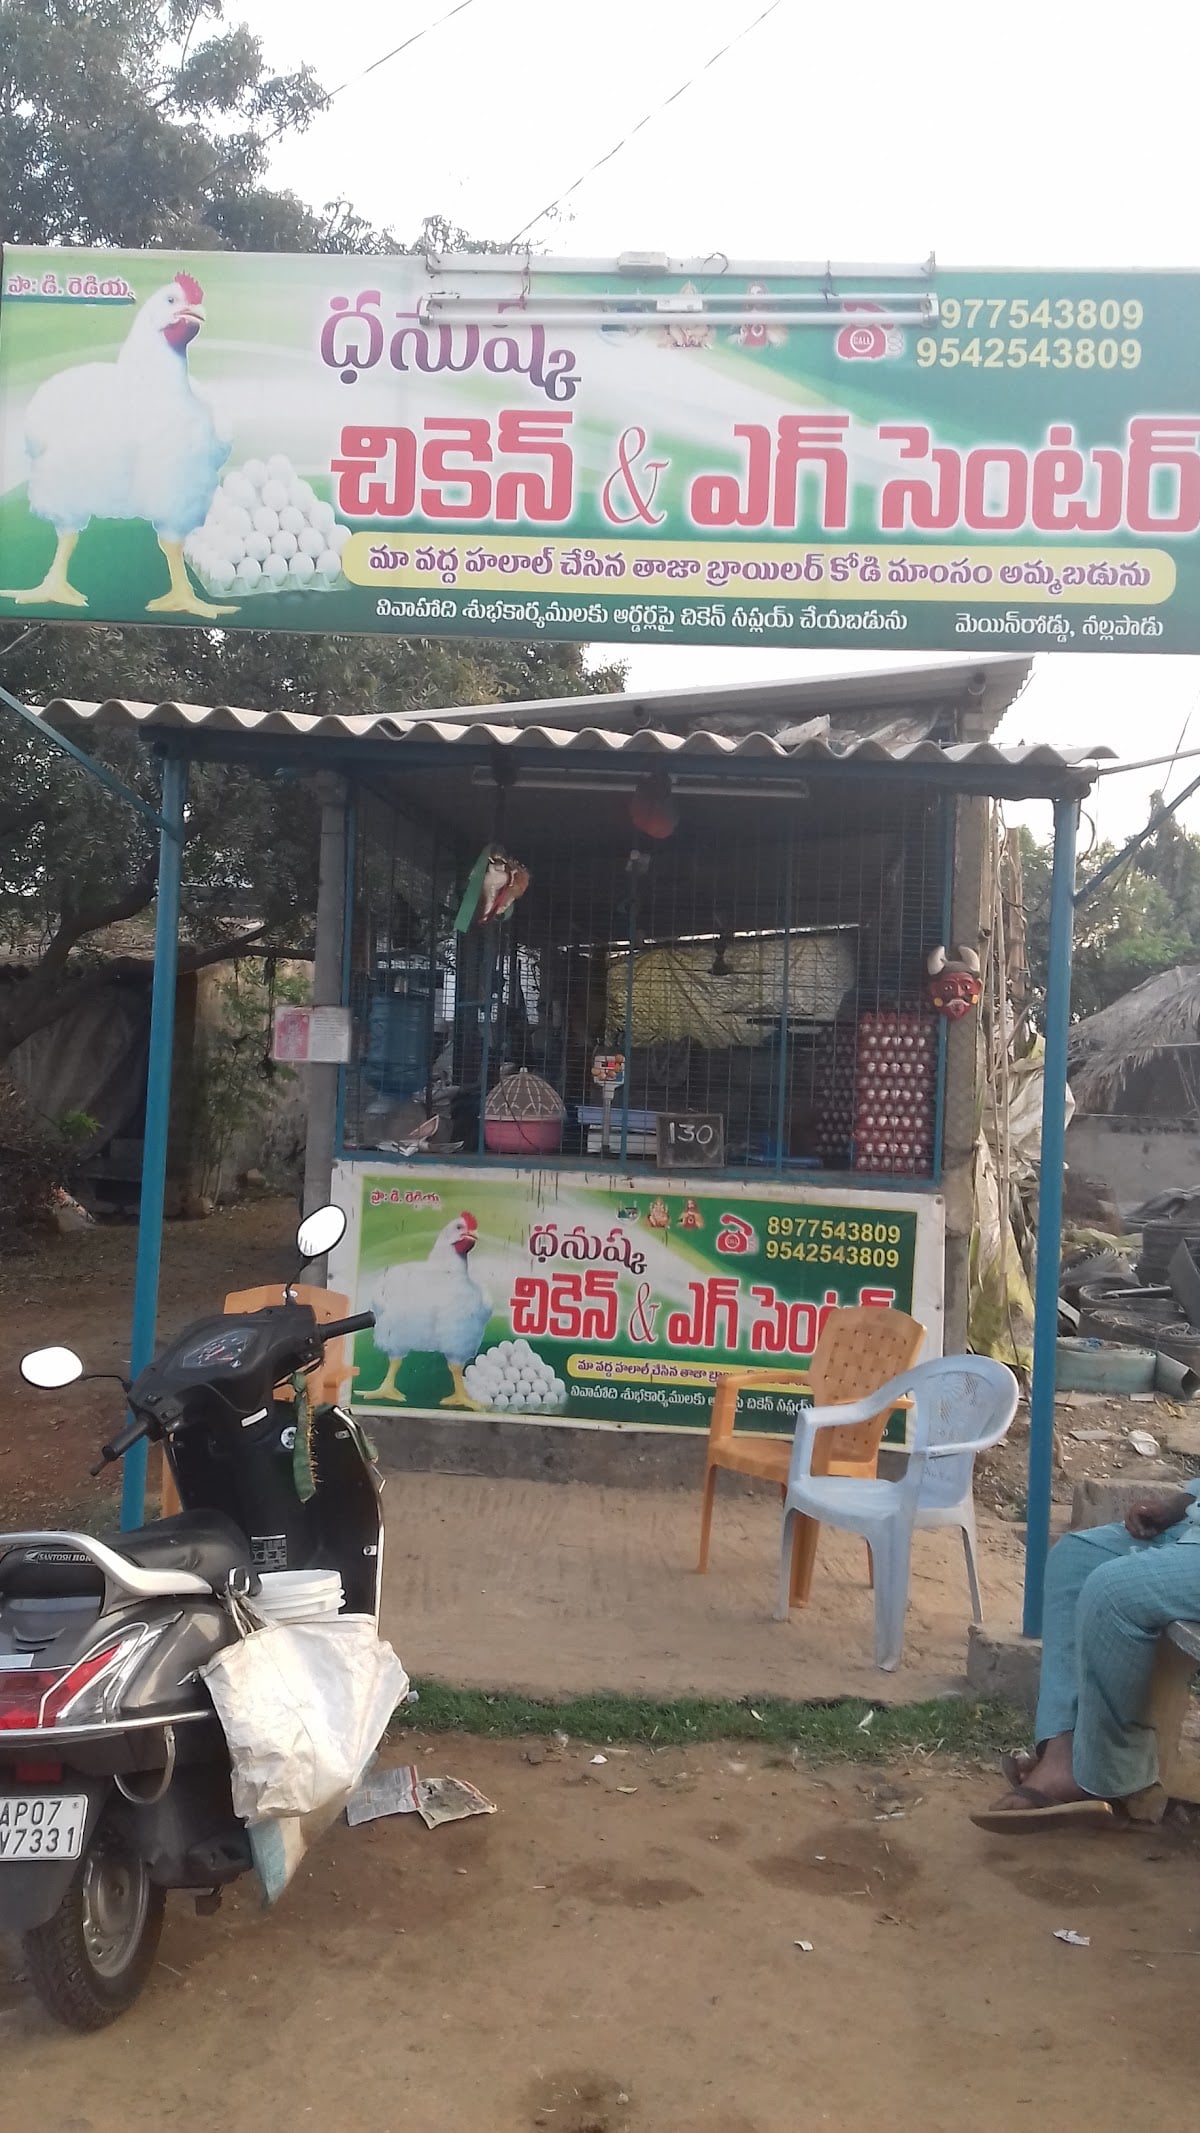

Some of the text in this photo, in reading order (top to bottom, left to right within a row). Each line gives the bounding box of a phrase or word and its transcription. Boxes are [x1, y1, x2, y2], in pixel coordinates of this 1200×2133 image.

[940, 299, 1144, 329] 977543809
[320, 290, 582, 401] ధనుష్క
[916, 338, 1142, 368] 9542543809
[330, 409, 1200, 532] చికెన్ & ఎగ్ సెంటర్
[370, 545, 1150, 595] మా వద్ద హలాల్ చేసిన తాజా బ్రాయిలర్ కోడి మాంసం అమ్మబడును
[376, 599, 457, 618] వివాహాది
[462, 598, 608, 629] శుభకార్యములకు
[680, 604, 726, 627] చికెన్
[799, 606, 907, 631] చేయబడును
[1082, 614, 1164, 641] నల్లపాడు
[669, 1122, 713, 1144] 130
[768, 1216, 901, 1244] 8977543809
[529, 1223, 648, 1275] ధనుష్క
[765, 1240, 900, 1269] 9542543809
[510, 1270, 619, 1341] చికెన్
[629, 1283, 661, 1344] &
[668, 1278, 741, 1348] ఎగ్
[577, 1360, 594, 1371] మా
[747, 1396, 774, 1411] చికెన్
[72, 1554, 92, 1563] HON
[0, 1800, 63, 1827] AP07
